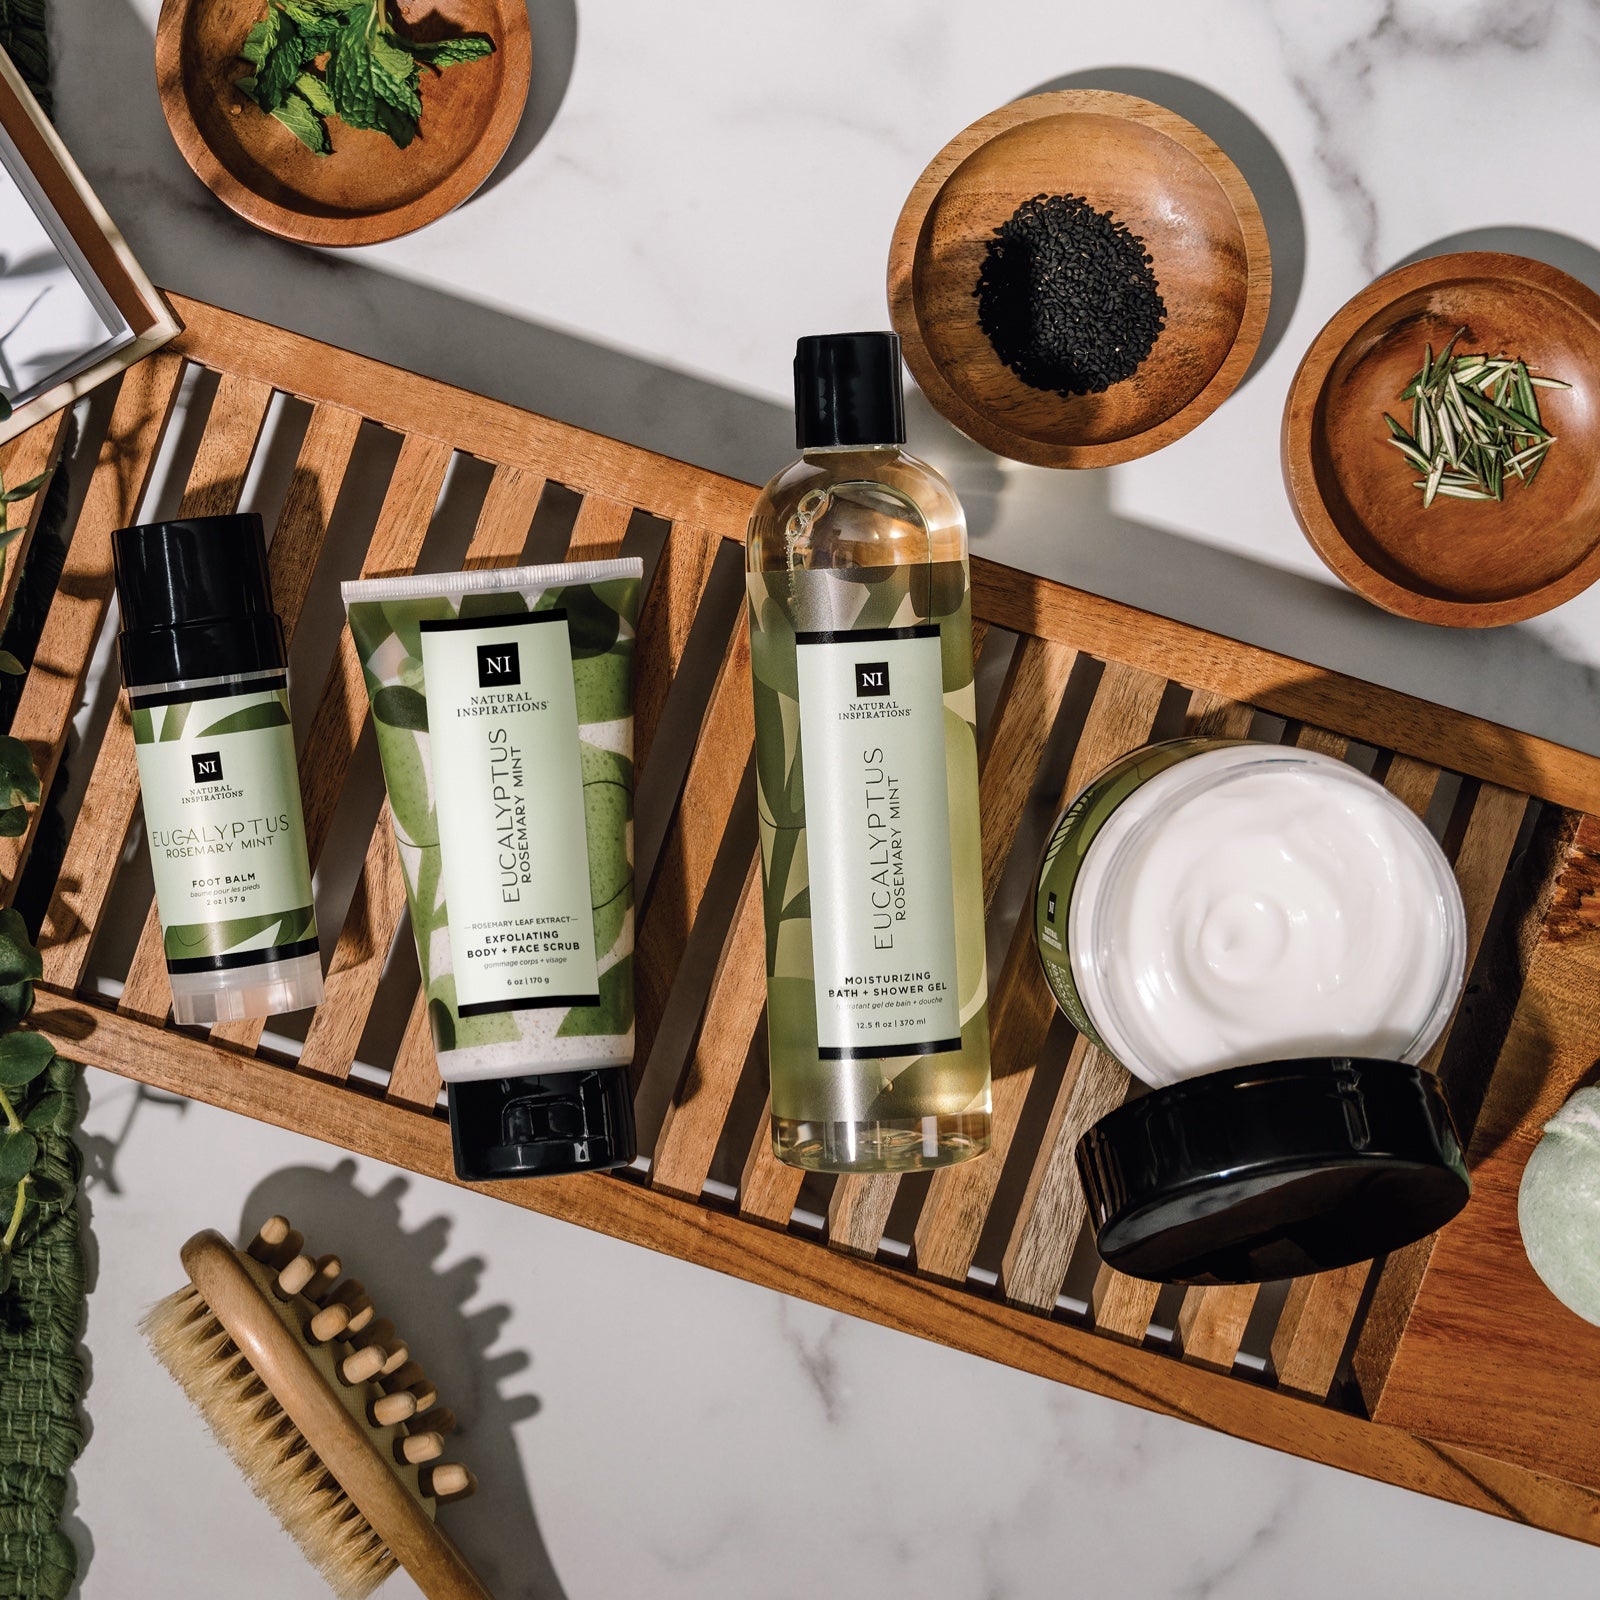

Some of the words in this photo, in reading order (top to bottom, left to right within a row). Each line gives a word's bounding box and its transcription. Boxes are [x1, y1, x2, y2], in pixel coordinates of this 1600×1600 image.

[486, 655, 511, 674] NI
[861, 671, 884, 687] NI
[470, 691, 532, 706] NATURAL
[849, 701, 899, 711] NATURAL
[457, 701, 548, 717] INSPIRATIONS
[838, 708, 911, 720] INSPIRATIONS
[197, 760, 217, 775] NI
[511, 746, 524, 787] MINT
[182, 790, 243, 804] INSPIRATIONS
[190, 784, 232, 795] NATURAL
[887, 776, 901, 819] MINT
[488, 728, 520, 903] EUCALYPTUS
[514, 795, 532, 883] ROSEMARY
[166, 841, 234, 859] ROSEMARY
[241, 835, 274, 850] MINT
[863, 748, 893, 950] EUCALYPTUS
[192, 877, 221, 888] FOOT
[225, 872, 256, 884] BALM
[890, 828, 906, 921] ROSEMARY
[213, 888, 229, 897] pour
[242, 882, 261, 893] pieds
[229, 895, 238, 903] 57
[472, 920, 513, 930] ROSEMARY
[515, 918, 534, 926] LEAF
[485, 930, 559, 944] EXFOLIATING
[467, 947, 498, 959] BODY
[511, 944, 540, 954] FACE
[543, 941, 580, 952] SCRUB
[483, 959, 519, 970] gommage
[519, 958, 539, 967] corps
[546, 956, 568, 965] visage
[530, 976, 543, 984] 170
[544, 977, 550, 985] g
[845, 971, 931, 985] MOISTURIZING
[828, 988, 858, 998] BATH
[873, 985, 924, 997] SHOWER
[928, 982, 947, 992] GEL
[872, 1002, 884, 1010] gel
[896, 1000, 911, 1008] bain
[919, 996, 943, 1006] douche
[900, 1019, 914, 1027] 370
